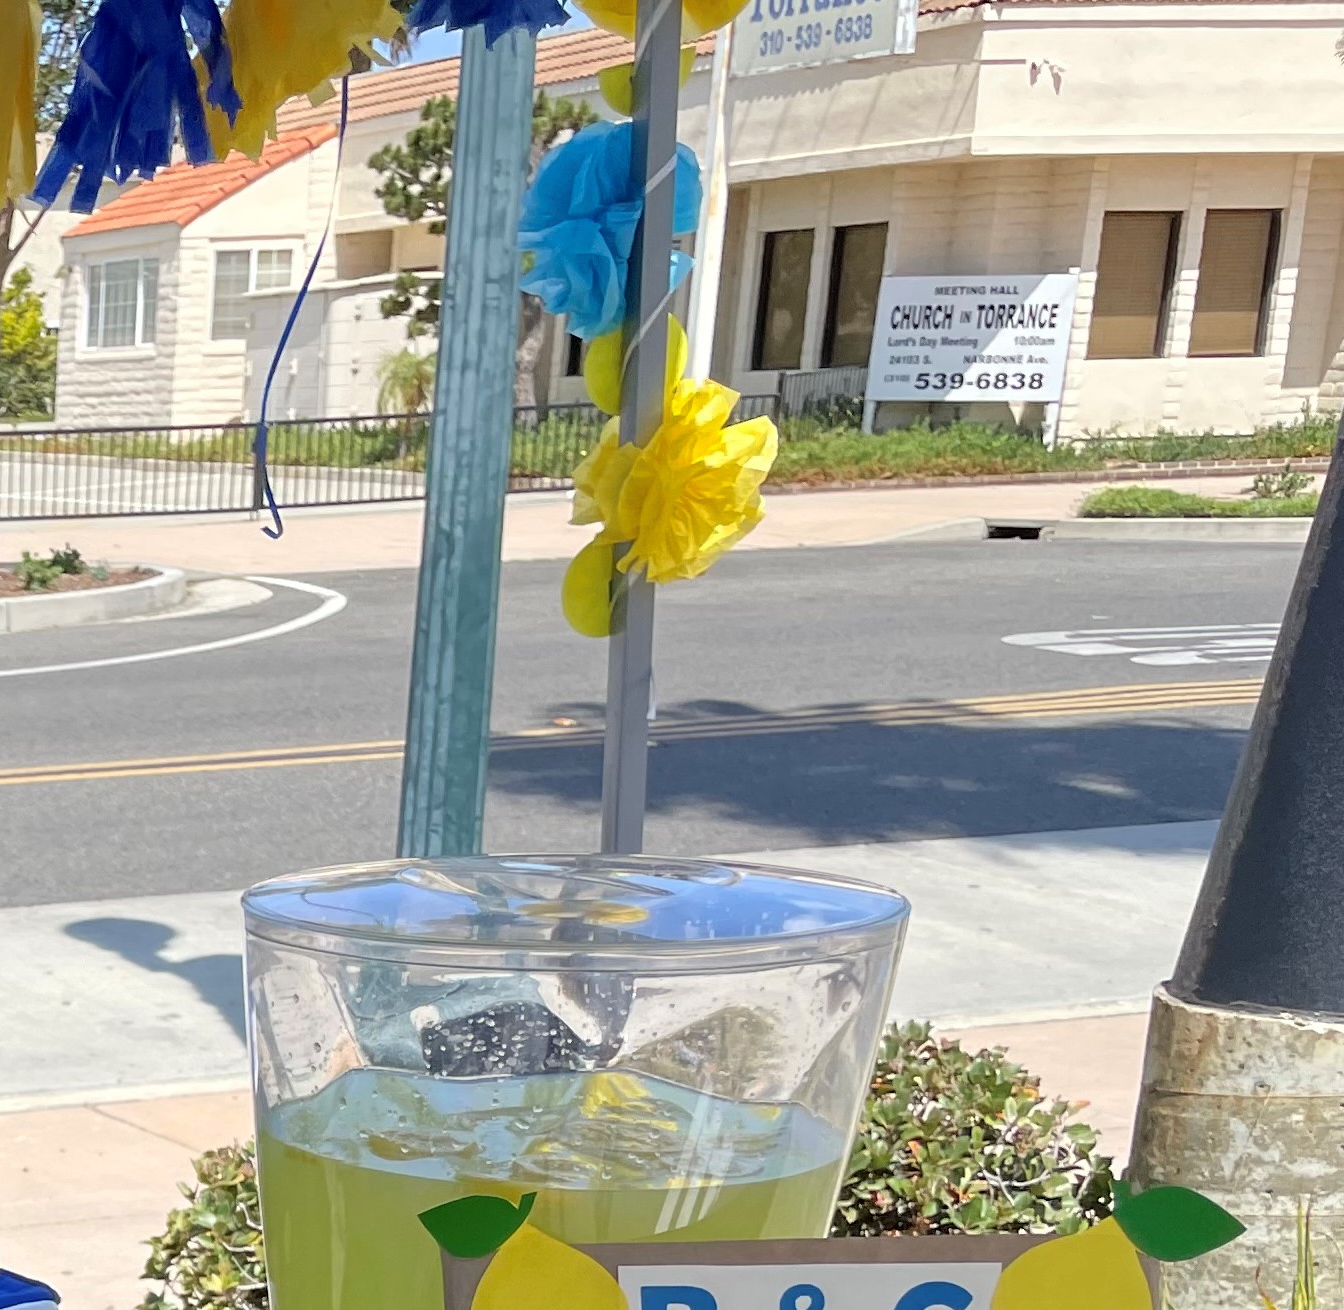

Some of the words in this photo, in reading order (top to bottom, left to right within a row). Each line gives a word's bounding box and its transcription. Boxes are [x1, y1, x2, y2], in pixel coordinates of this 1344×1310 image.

[934, 286, 986, 296] MEETING
[990, 286, 1019, 295] HALL
[890, 304, 955, 329] CHURCH
[960, 311, 972, 323] IN
[976, 304, 1060, 329] TORRANCE
[919, 336, 937, 349] Day
[941, 336, 978, 349] Meeting
[963, 355, 1023, 364] NARBONNE
[914, 373, 1044, 390] 539-6838
